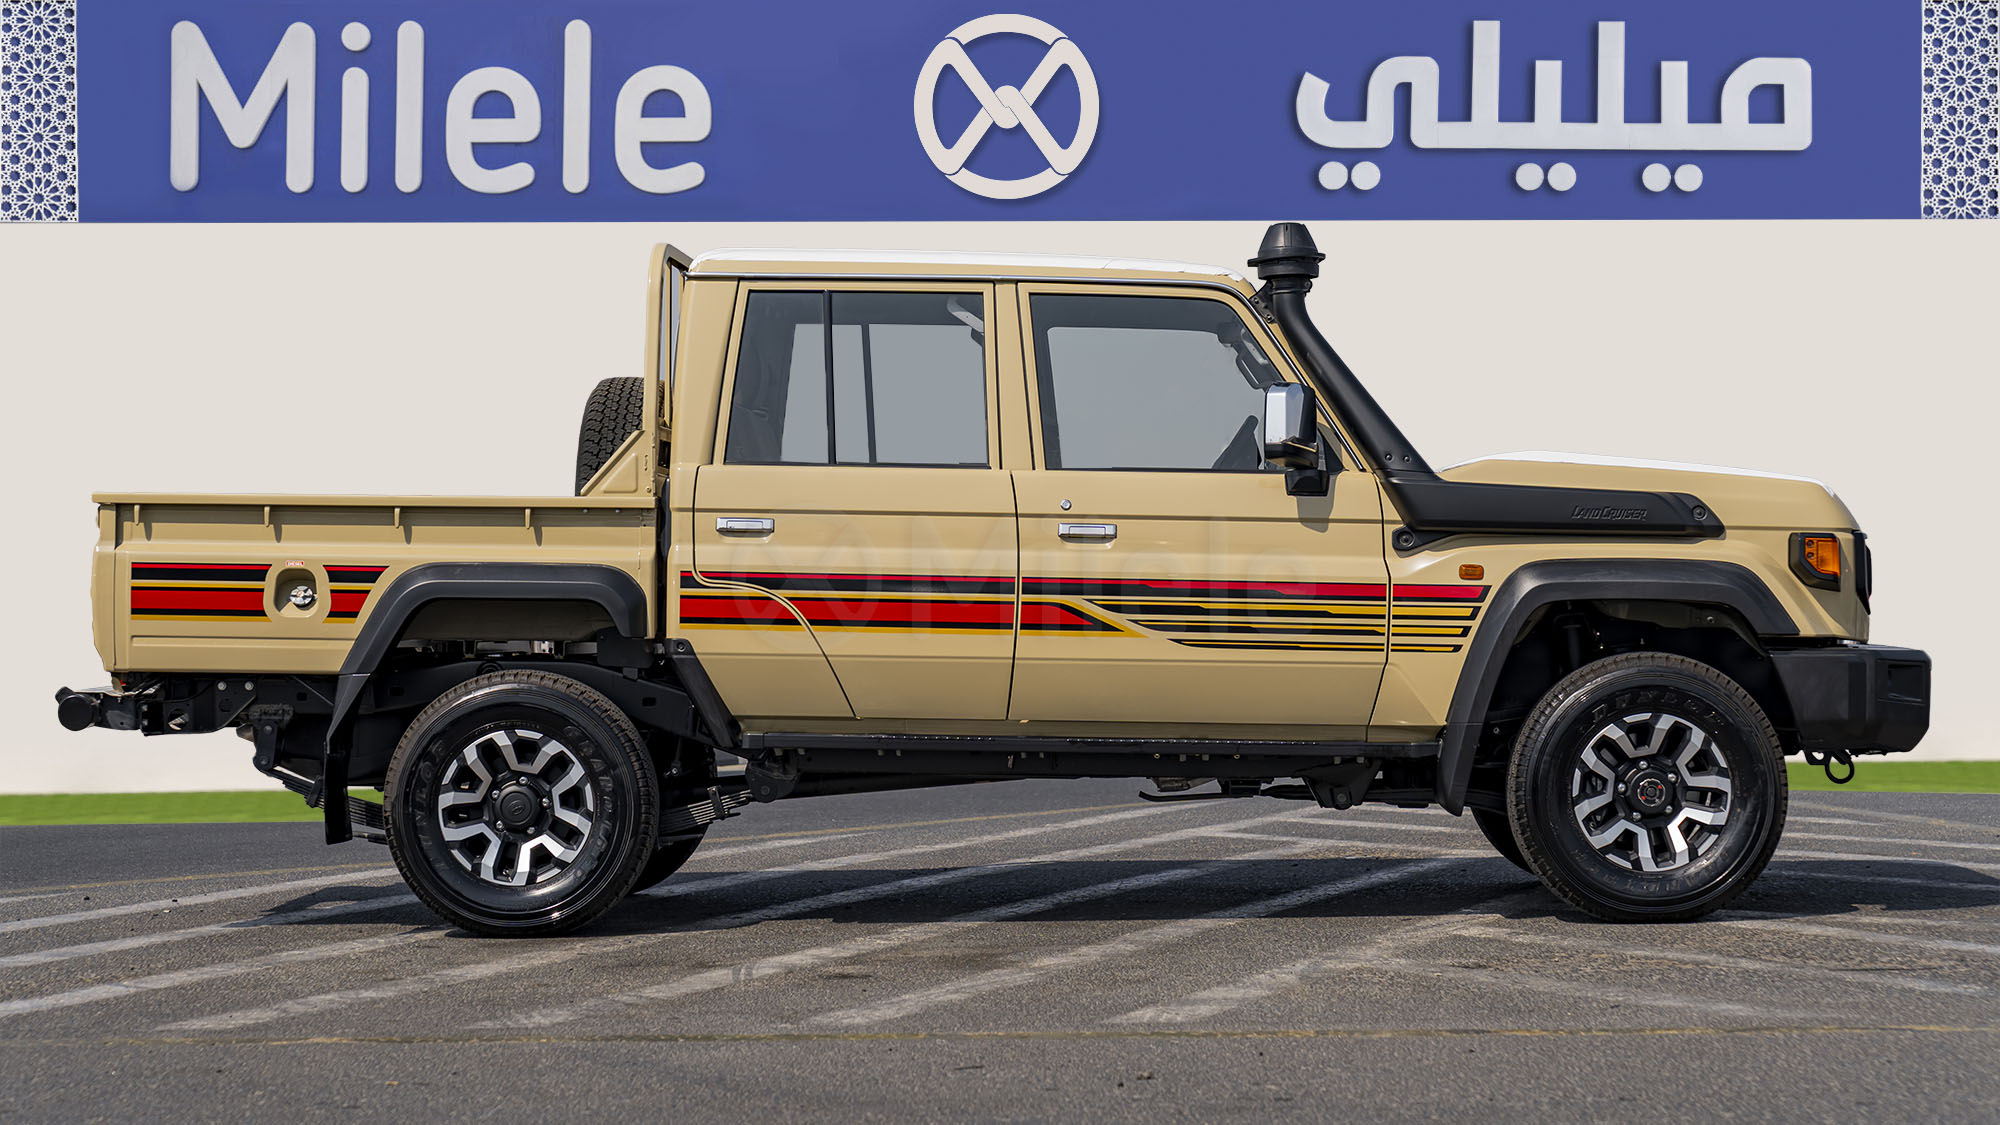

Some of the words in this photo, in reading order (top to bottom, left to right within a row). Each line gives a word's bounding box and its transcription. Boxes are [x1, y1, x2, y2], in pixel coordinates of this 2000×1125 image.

[170, 19, 712, 194] Milele
[1296, 20, 1812, 192] ميليلي
[1571, 505, 1600, 519] LAND
[1600, 506, 1648, 521] CRUISER
